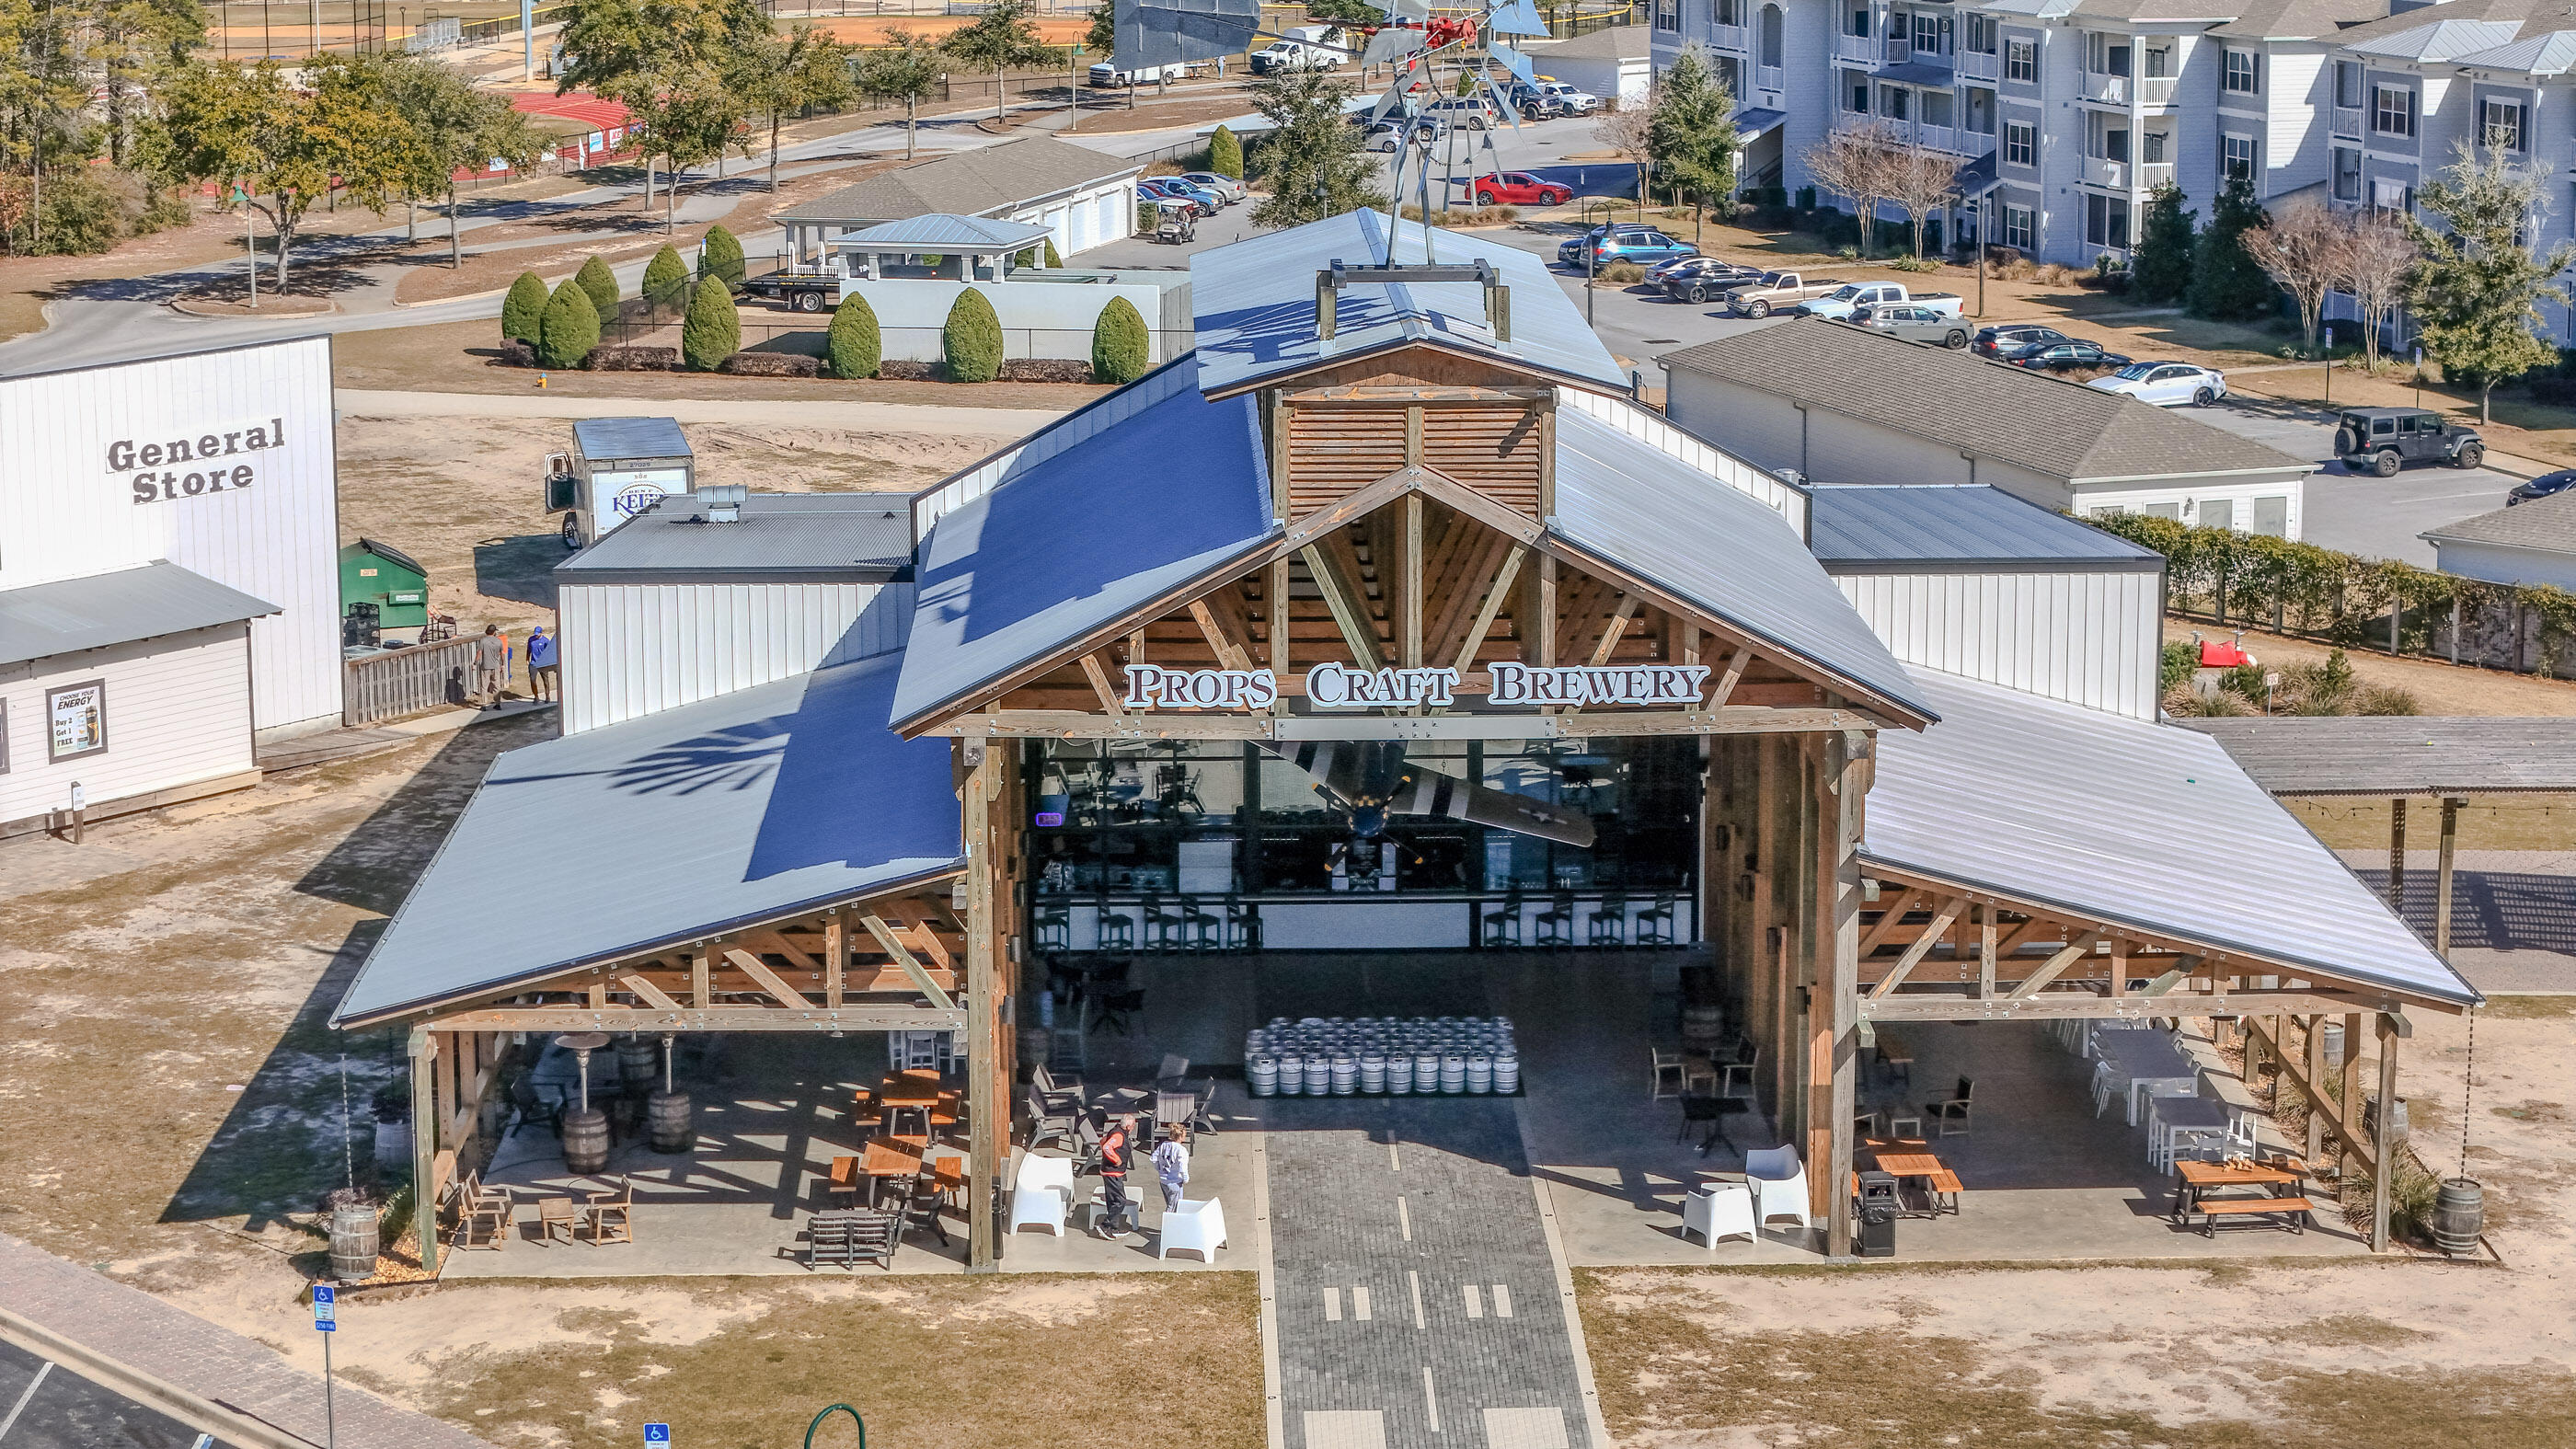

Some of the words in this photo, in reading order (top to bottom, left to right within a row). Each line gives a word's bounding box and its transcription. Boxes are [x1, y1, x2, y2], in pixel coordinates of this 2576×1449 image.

[108, 418, 284, 471] General
[132, 465, 253, 504] Store
[613, 493, 665, 515] KEIT
[1128, 668, 1274, 704] PROPS
[1310, 666, 1457, 703] CRAFT
[1491, 666, 1708, 701] BREWERY
[57, 695, 94, 710] ENERGY
[59, 692, 80, 701] CHOOSE
[57, 737, 74, 747] FREE
